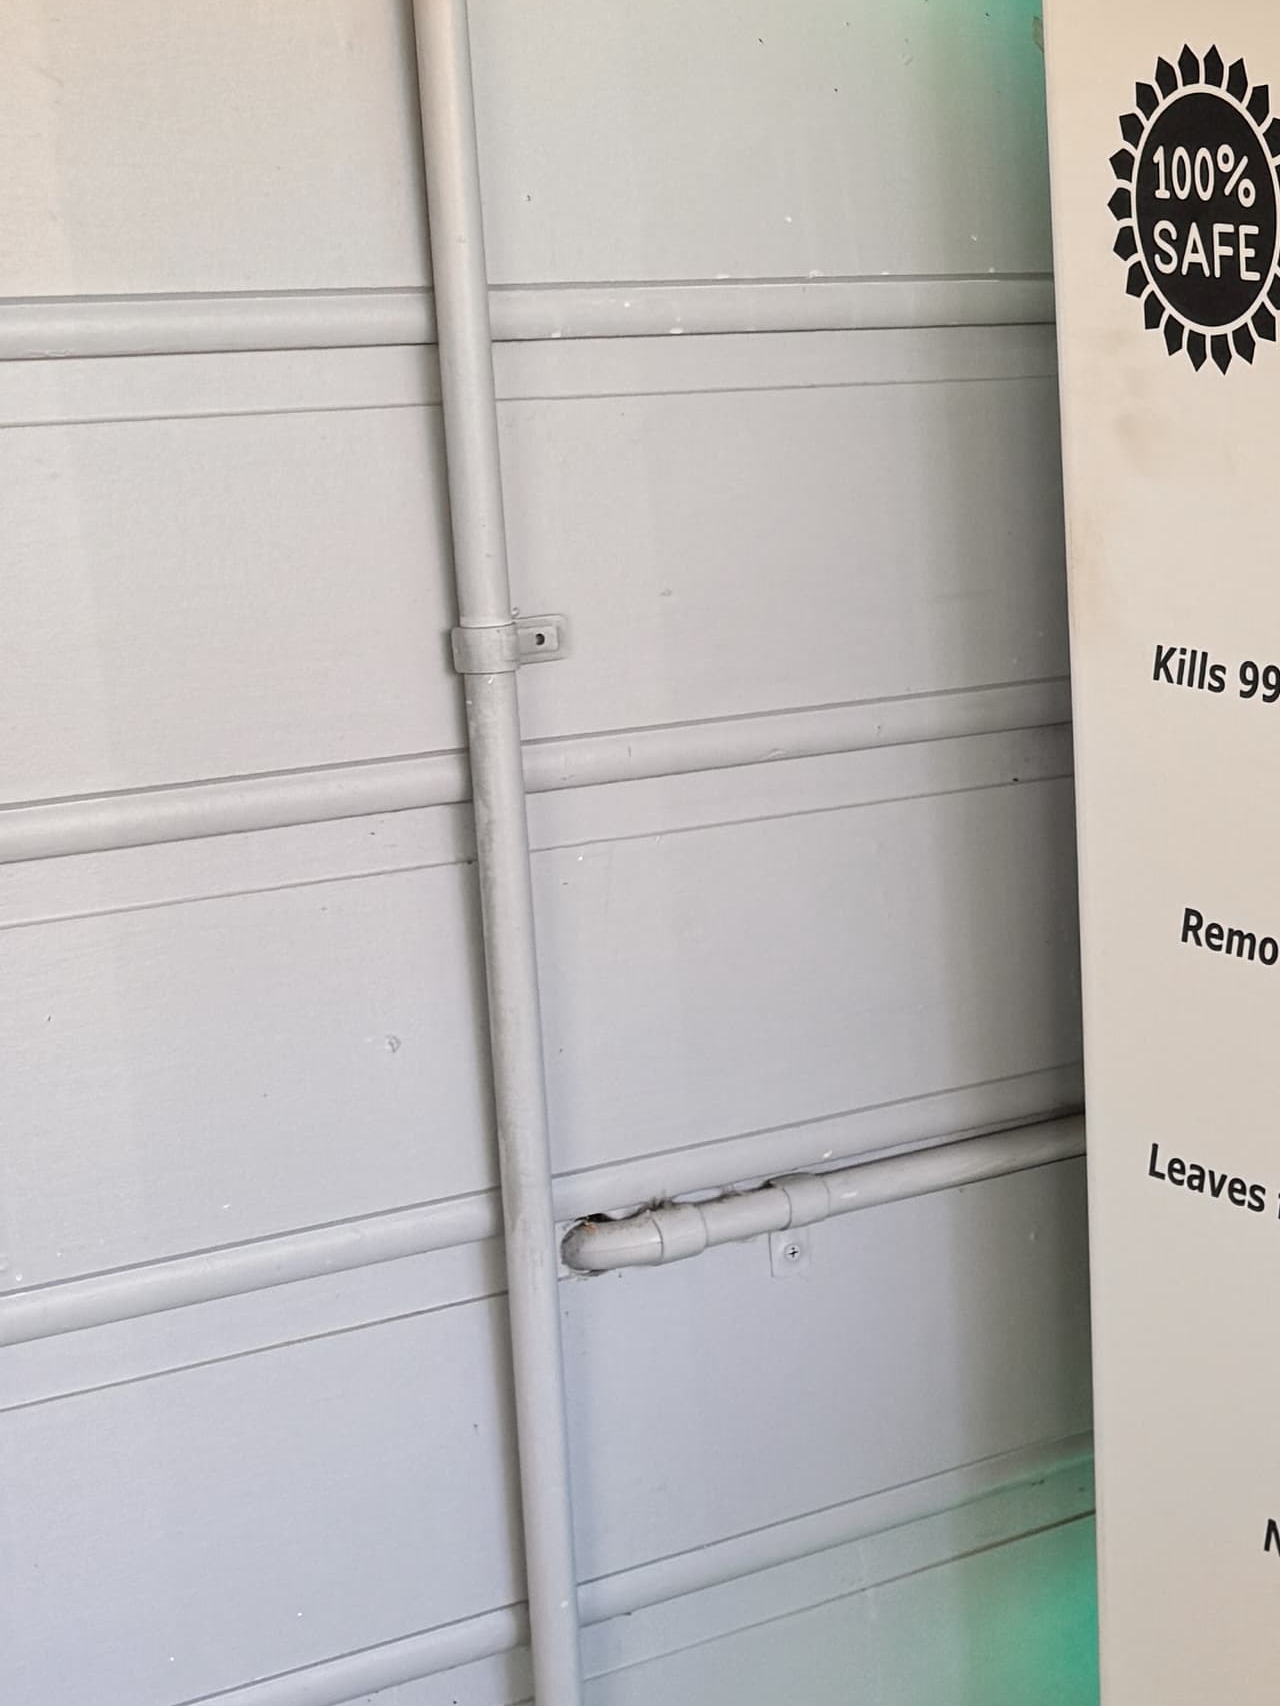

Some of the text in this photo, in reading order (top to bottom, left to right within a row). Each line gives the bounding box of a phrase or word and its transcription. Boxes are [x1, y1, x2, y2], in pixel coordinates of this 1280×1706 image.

[1152, 144, 1257, 209] 100%
[1152, 222, 1261, 282] SAFE
[1152, 644, 1227, 695] Kills
[1148, 1143, 1266, 1215] Leaves
